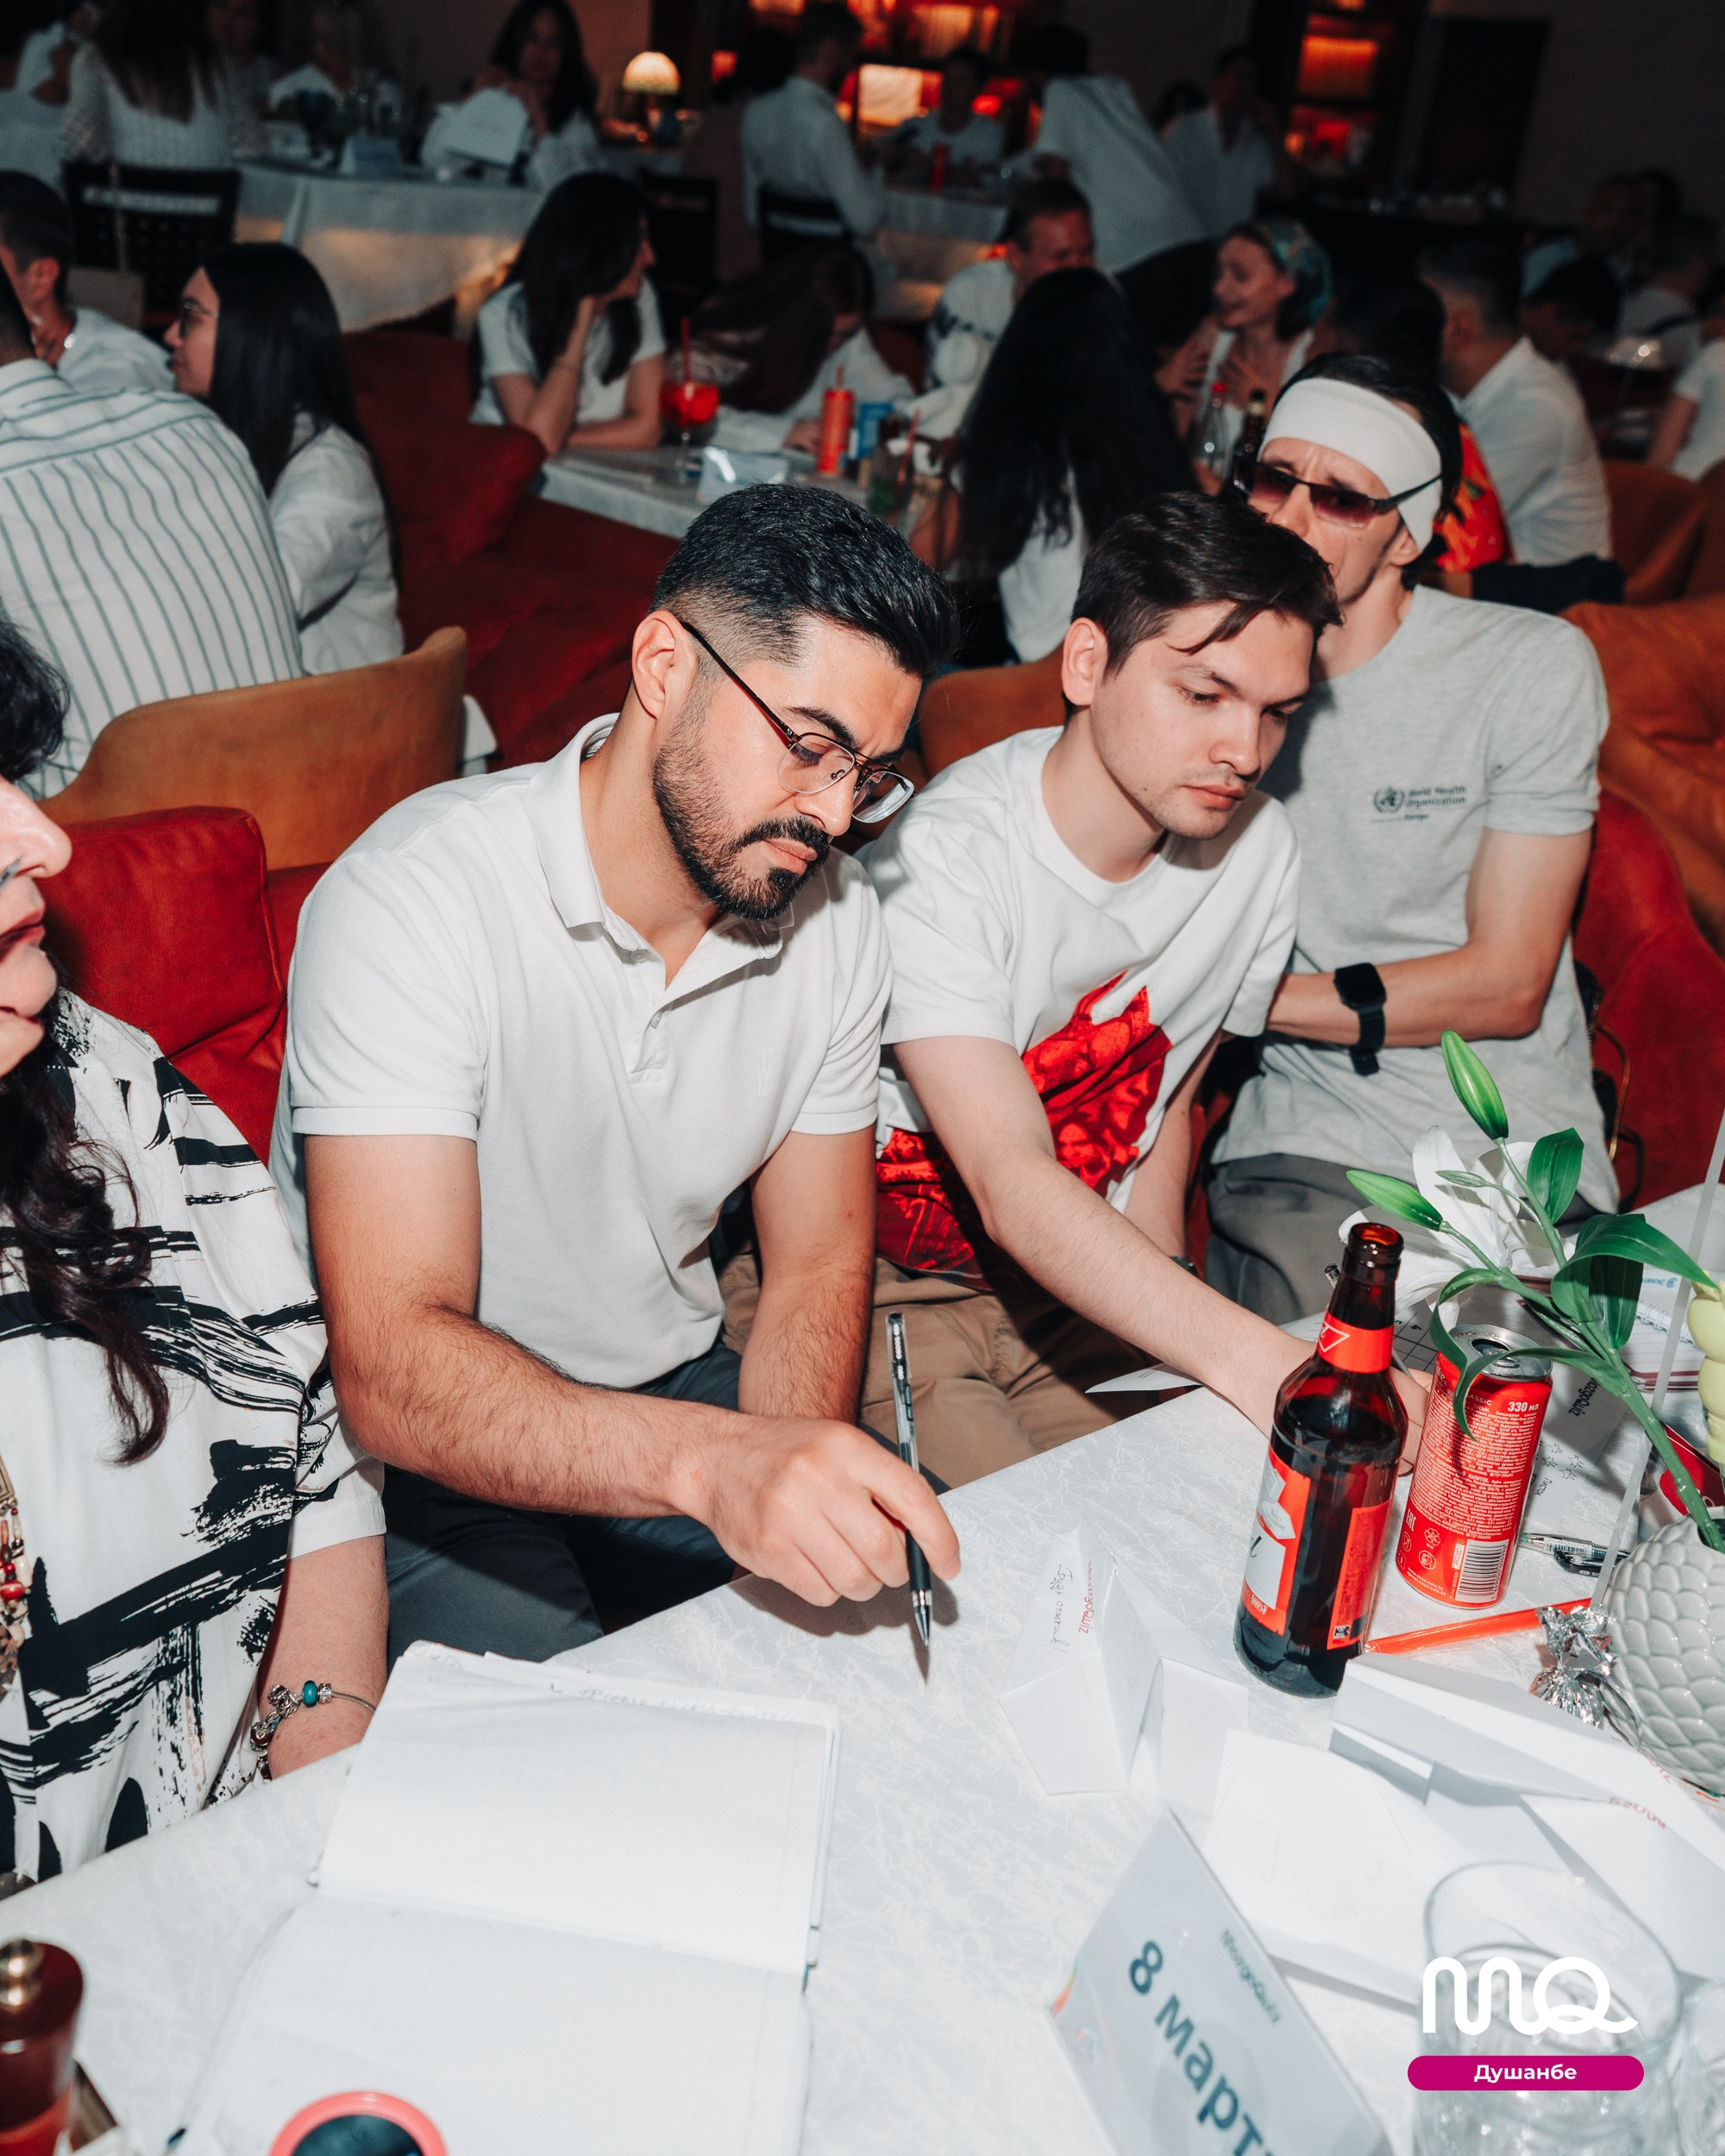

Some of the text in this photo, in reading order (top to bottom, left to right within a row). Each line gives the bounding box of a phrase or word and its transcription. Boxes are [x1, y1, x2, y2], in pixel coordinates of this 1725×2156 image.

[1434, 785, 1465, 794] Health
[1507, 1401, 1528, 1413] 330
[1128, 1940, 1276, 2156] 8 март
